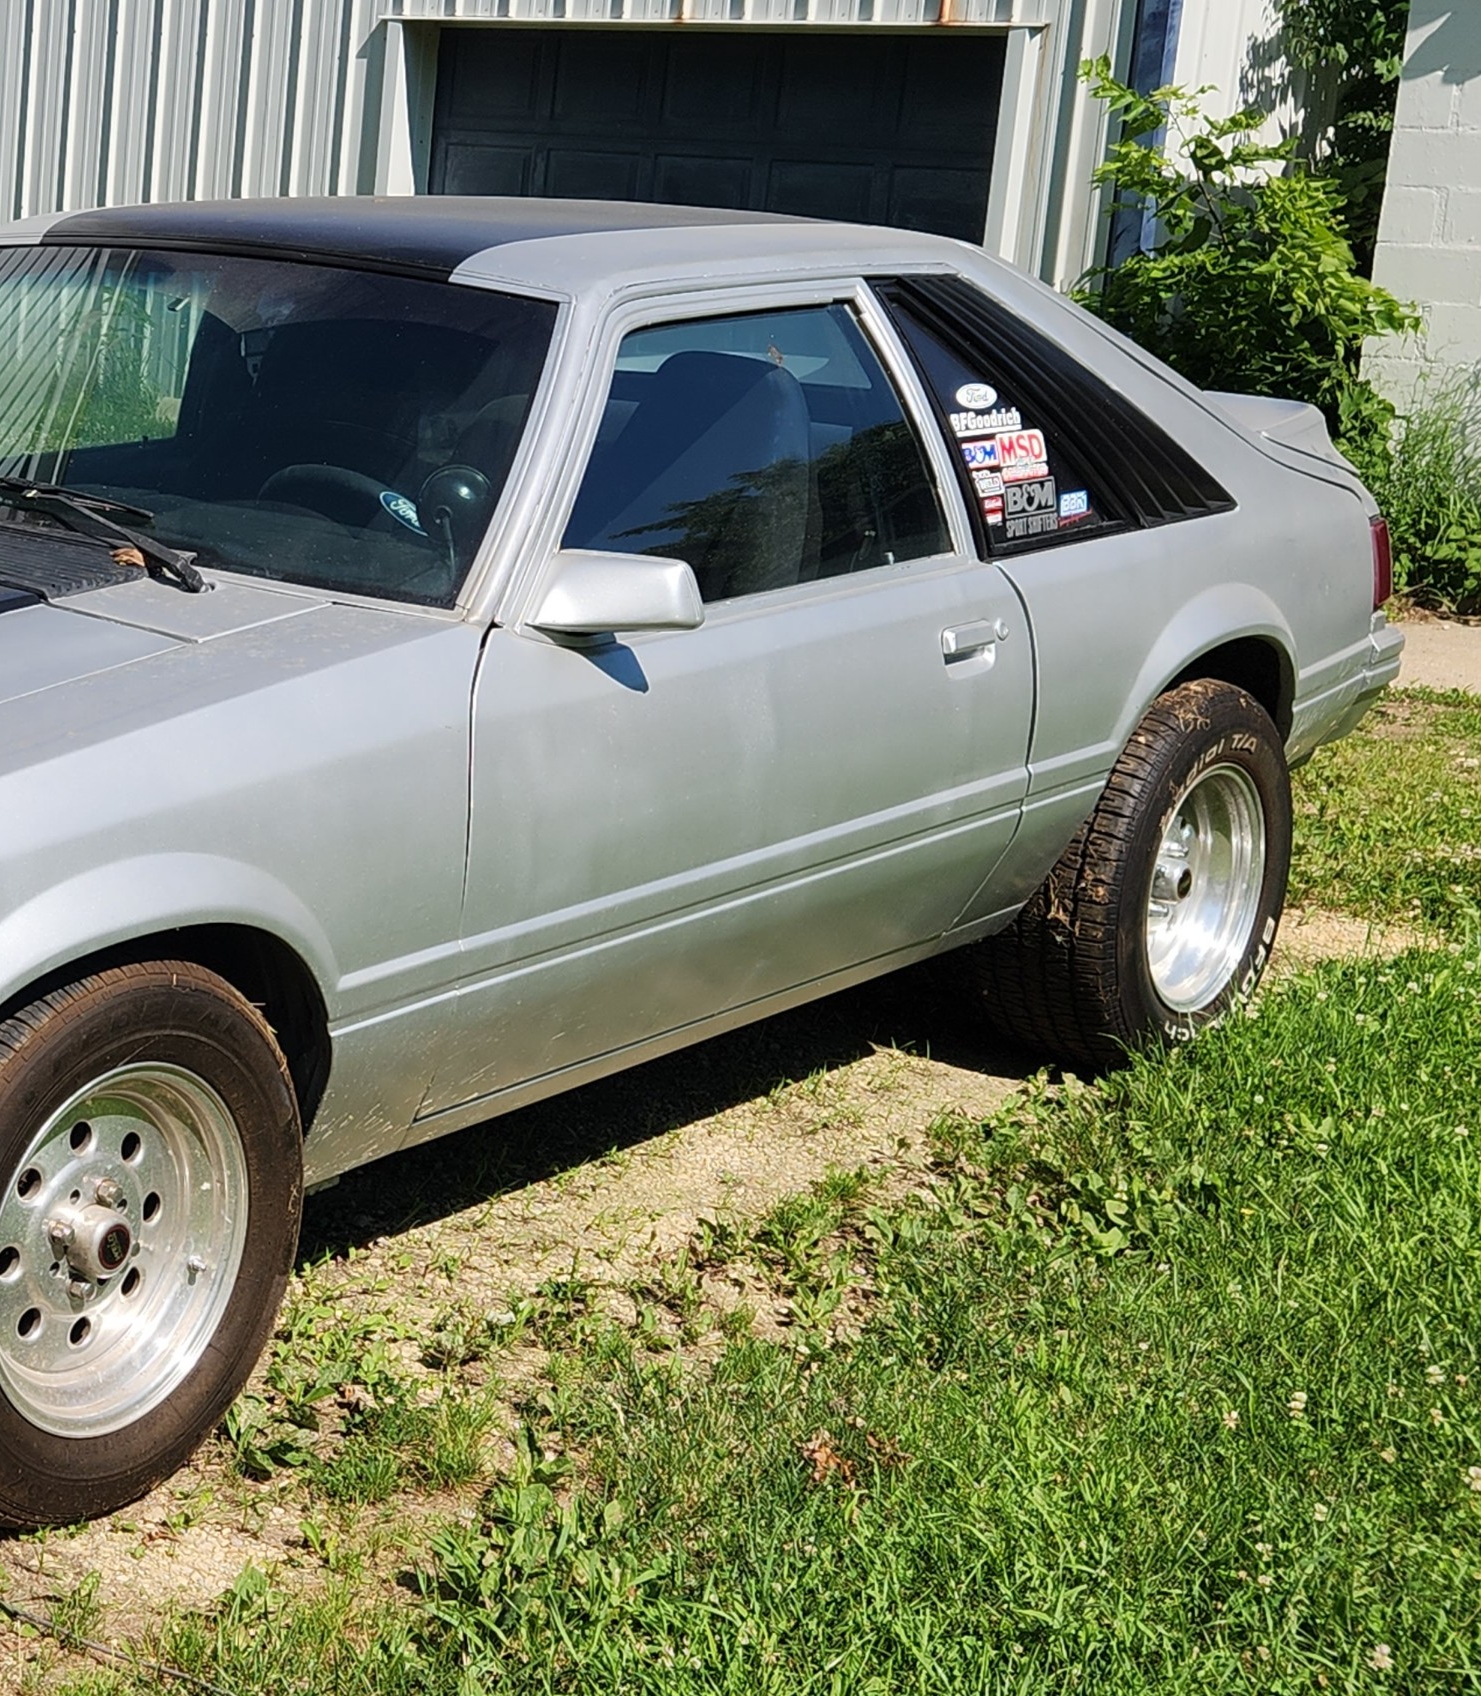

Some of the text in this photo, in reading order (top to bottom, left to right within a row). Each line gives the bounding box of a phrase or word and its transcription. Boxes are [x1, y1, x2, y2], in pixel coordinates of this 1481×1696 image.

[965, 387, 989, 403] Ford
[950, 406, 1021, 432] BFGoodrich
[998, 433, 1043, 465] MSD
[1006, 481, 1054, 512] B&M
[1006, 517, 1027, 538] SPORT
[1028, 512, 1059, 535] SHIFTERS
[1230, 733, 1257, 753] T/A
